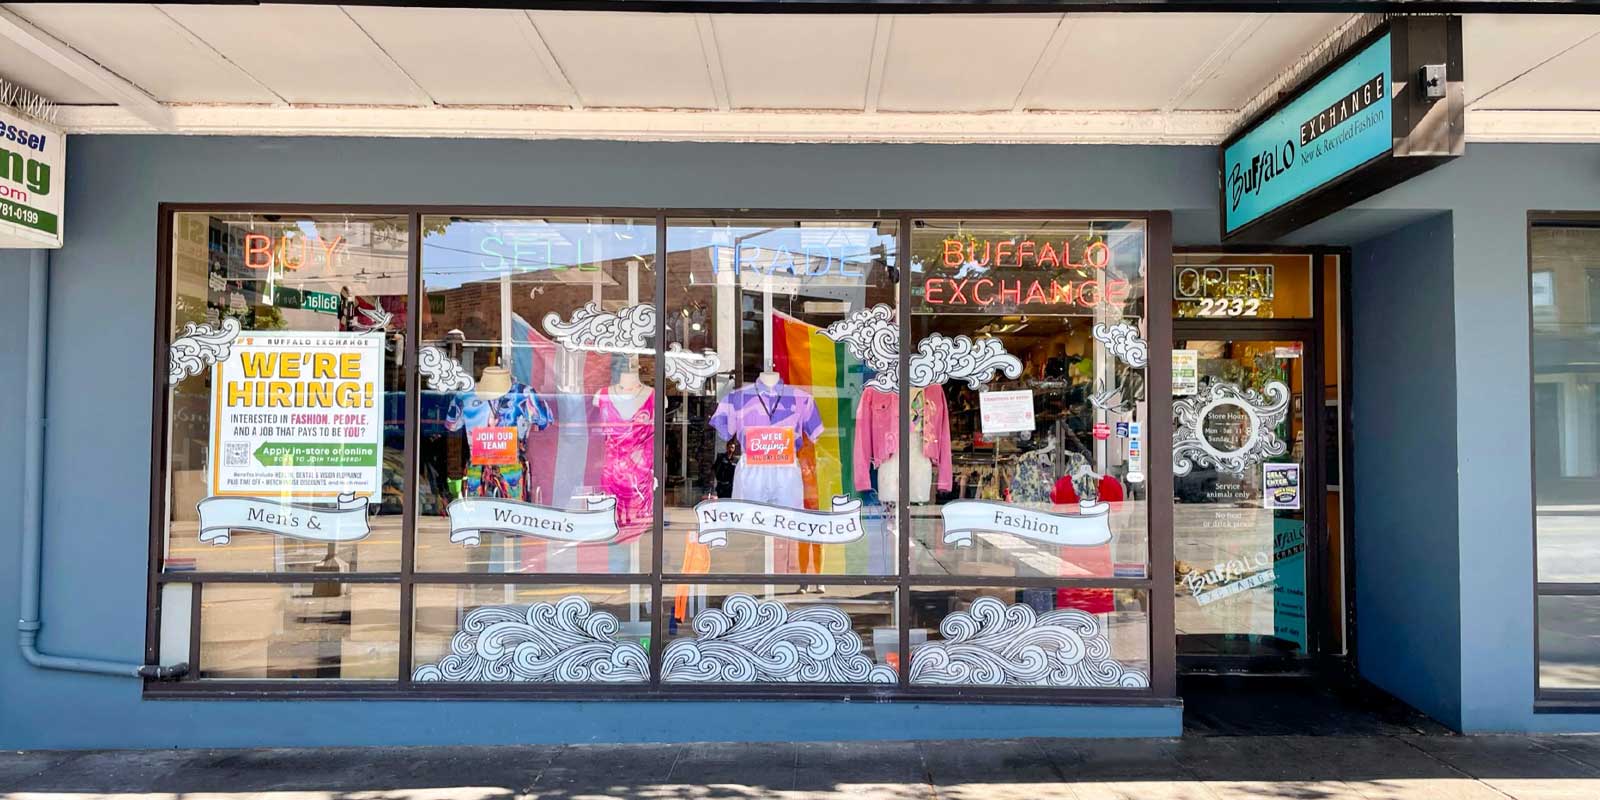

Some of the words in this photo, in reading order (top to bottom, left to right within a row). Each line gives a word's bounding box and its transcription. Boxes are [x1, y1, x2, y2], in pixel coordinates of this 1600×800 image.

[1300, 75, 1384, 146] EXCHANGE
[1301, 150, 1315, 166] New
[1315, 146, 1322, 158] &
[1323, 128, 1354, 153] Recycled
[1354, 109, 1384, 136] Fashion
[244, 234, 342, 272] BUY
[480, 236, 600, 272] SELL
[709, 242, 865, 277] TRADE
[943, 240, 1111, 269] BUFFALO
[924, 278, 1128, 307] EXCHANGE
[1178, 267, 1273, 298] OPEN
[1198, 298, 1260, 316] 2232
[240, 351, 362, 379] WE'RE
[227, 381, 374, 408] HIRING!
[230, 414, 278, 425] INTERESTED
[279, 414, 288, 424] IN
[233, 427, 250, 437] AND
[252, 427, 257, 437] A
[259, 427, 274, 437] JOB
[276, 427, 295, 437] THAT
[297, 427, 317, 437] PAYS
[319, 427, 330, 437] TO
[332, 427, 342, 437] BE
[343, 427, 366, 438] YOU?
[476, 432, 494, 441] JOIN
[497, 432, 513, 441] OUR
[482, 441, 507, 449] TEAM!
[263, 447, 290, 456] Apply
[292, 447, 330, 455] in-store
[345, 447, 373, 455] online
[1234, 491, 1250, 499] only
[247, 508, 299, 527] Men's
[306, 516, 321, 530] &
[493, 508, 574, 533] Women's
[703, 509, 744, 524] New
[751, 511, 766, 526] &
[774, 514, 857, 537] Recycled
[994, 510, 1059, 536] Fashion
